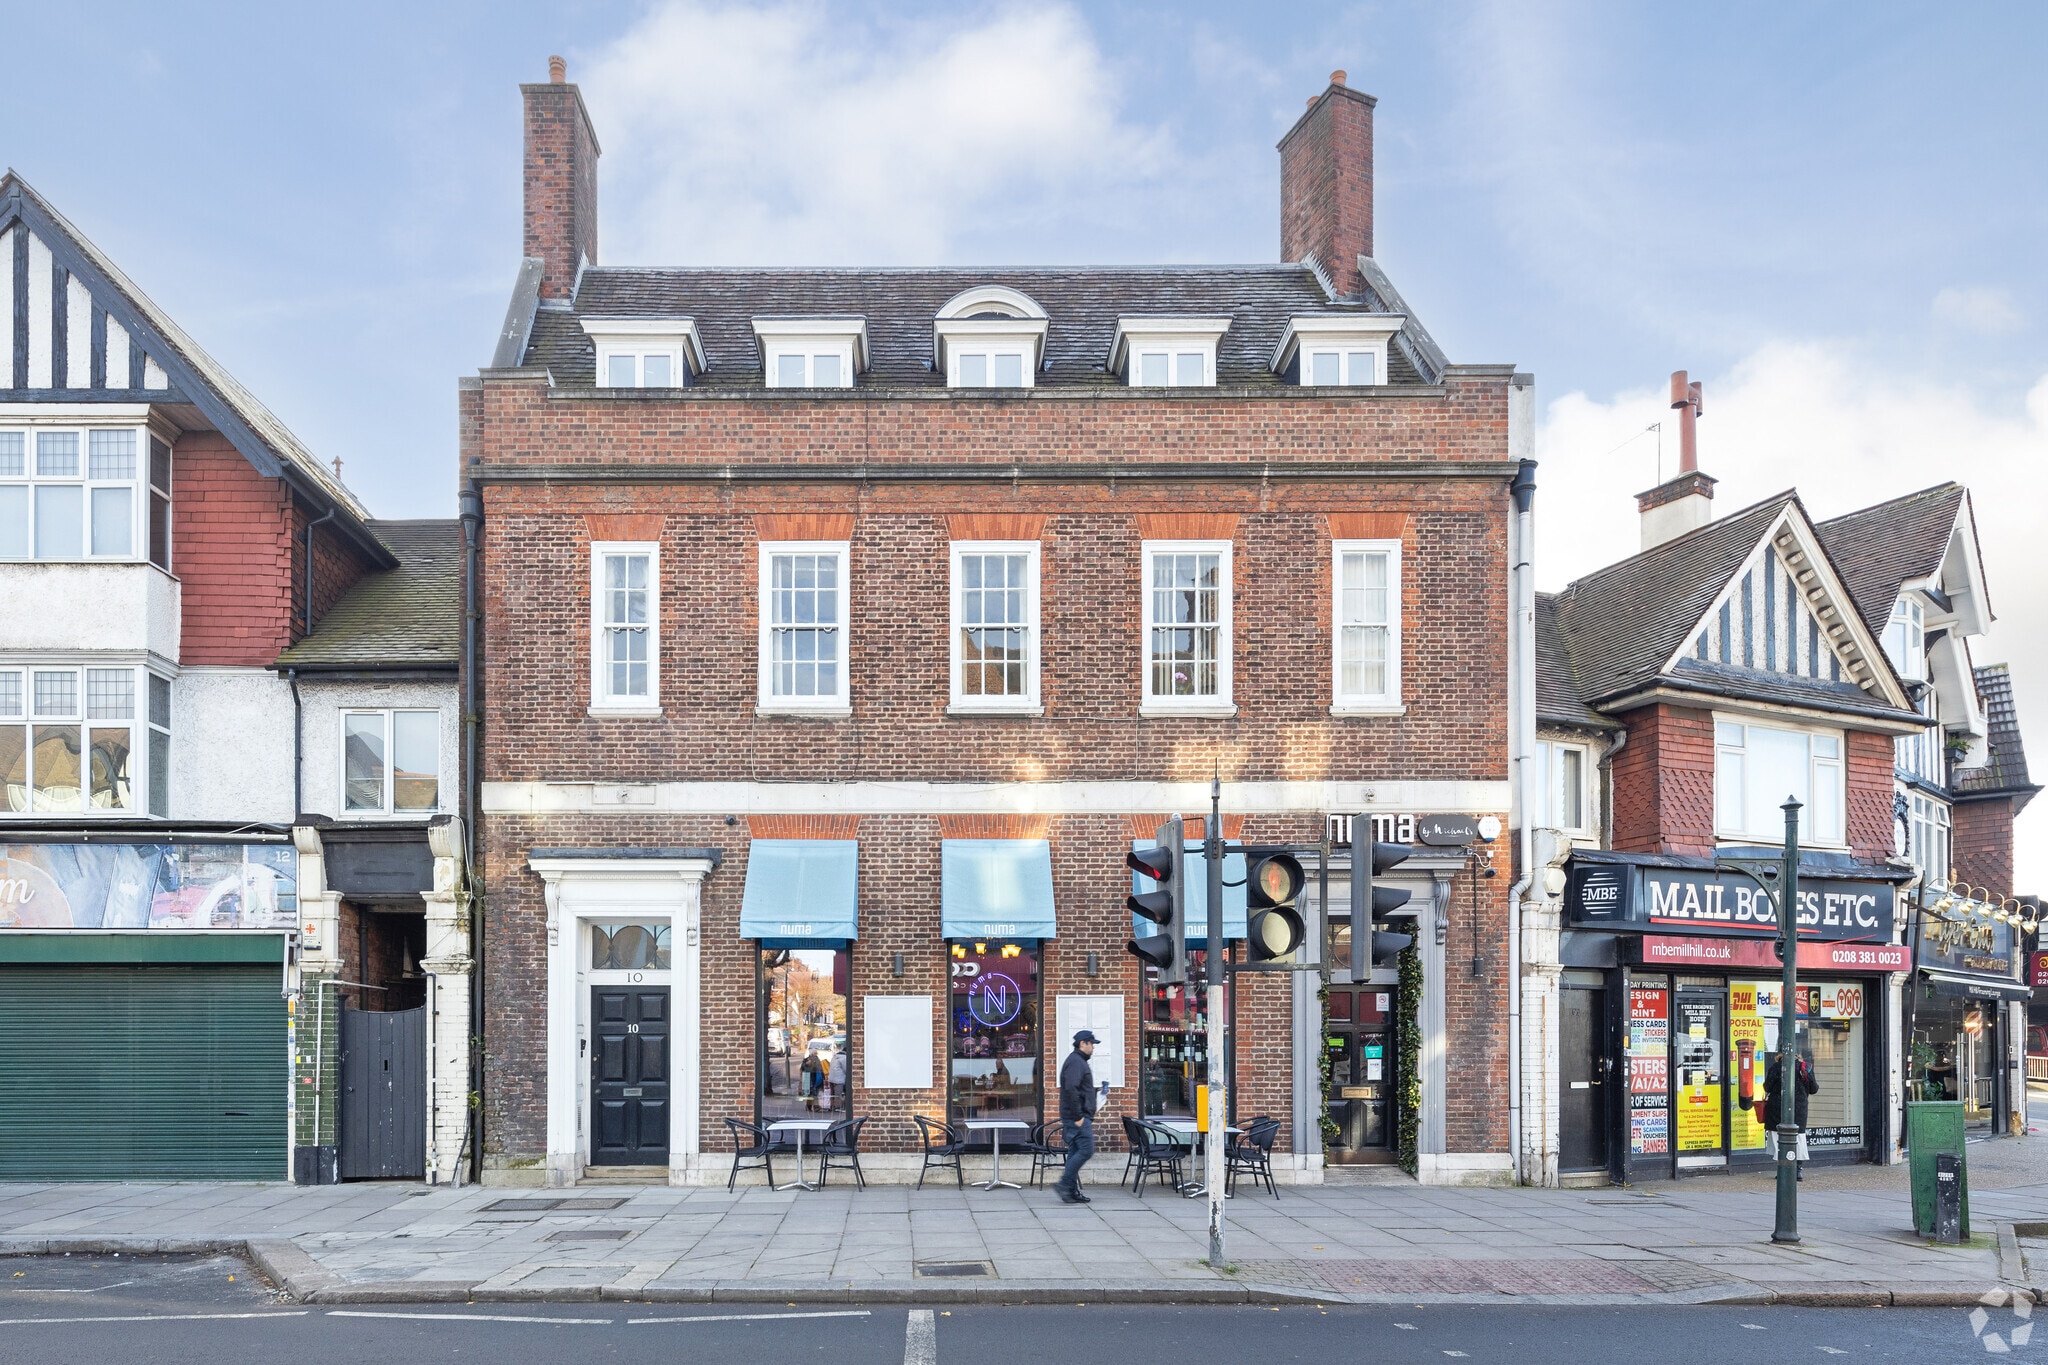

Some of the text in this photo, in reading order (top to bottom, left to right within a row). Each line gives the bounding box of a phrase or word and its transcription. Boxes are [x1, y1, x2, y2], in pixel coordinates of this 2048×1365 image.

[1327, 814, 1415, 843] nma
[1422, 826, 1430, 838] by
[276, 850, 290, 862] 12
[0, 878, 36, 904] m
[1586, 886, 1618, 900] MBE
[1650, 881, 1878, 928] MAIL BOES ETC.
[780, 924, 812, 935] numa
[984, 924, 1016, 935] numa
[1187, 925, 1208, 936] num
[1652, 942, 1731, 958] mbemillhill.co.uk
[1832, 950, 1902, 964] 0208 381 0023
[628, 972, 643, 982] 10
[969, 972, 992, 996] numa
[984, 985, 1006, 1015] N
[1630, 992, 1660, 1000] ESIGN
[1732, 992, 1752, 1010] DHL
[1757, 992, 1778, 1006] FedEx
[1637, 1000, 1644, 1008] &
[1838, 993, 1861, 1012] TNT
[1632, 1009, 1656, 1018] RINT
[627, 1024, 639, 1034] 10
[1730, 1020, 1762, 1028] POSTAL
[1631, 1060, 1667, 1074] STERS
[1631, 1076, 1667, 1091] /A1/A2
[1635, 1096, 1643, 1106] OF
[1644, 1096, 1667, 1106] SERVICE
[1643, 1140, 1666, 1152] BANNERS
[1810, 1137, 1835, 1145] SCANNING
